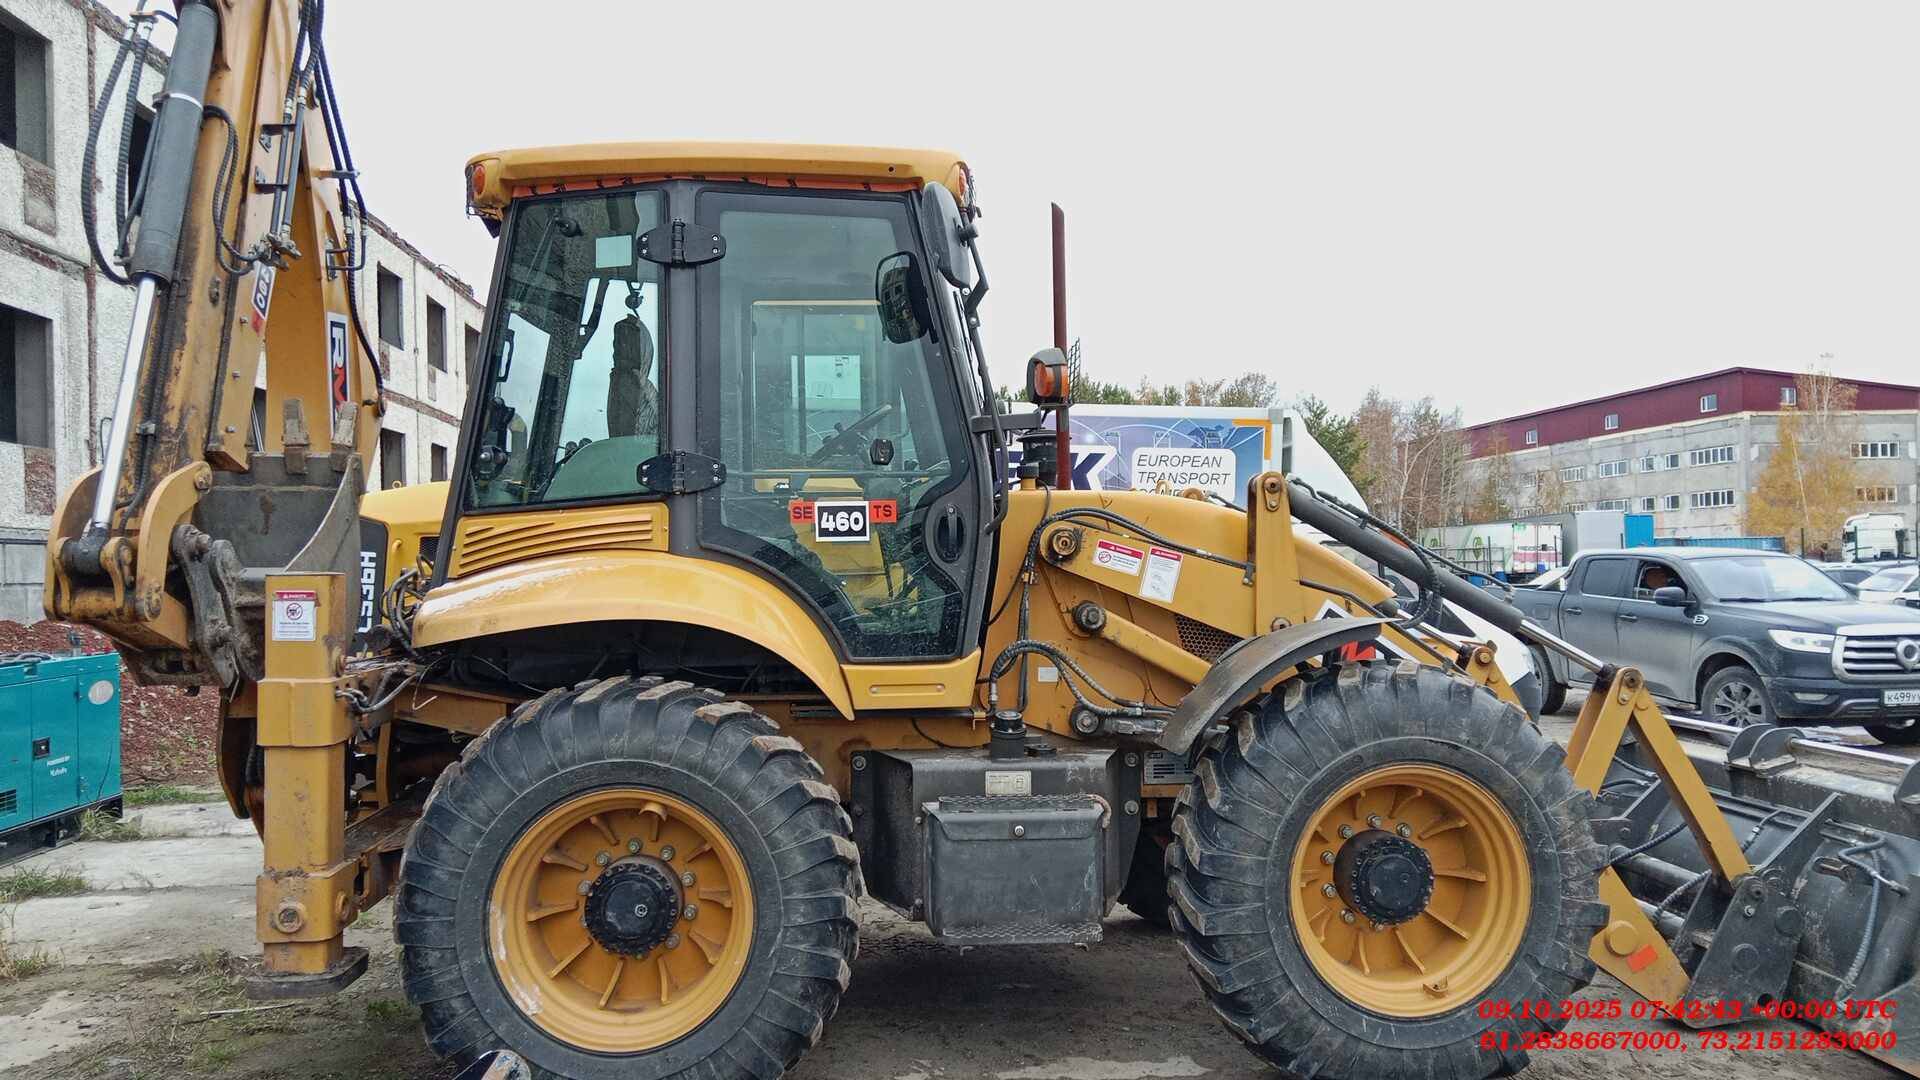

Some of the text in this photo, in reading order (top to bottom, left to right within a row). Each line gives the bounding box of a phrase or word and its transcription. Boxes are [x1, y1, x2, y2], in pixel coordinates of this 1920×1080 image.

[1136, 454, 1223, 468] EUROPEAN
[1137, 471, 1231, 485] TRANSPORT
[792, 505, 813, 520] SE
[873, 504, 892, 519] TS
[820, 511, 864, 532] 460
